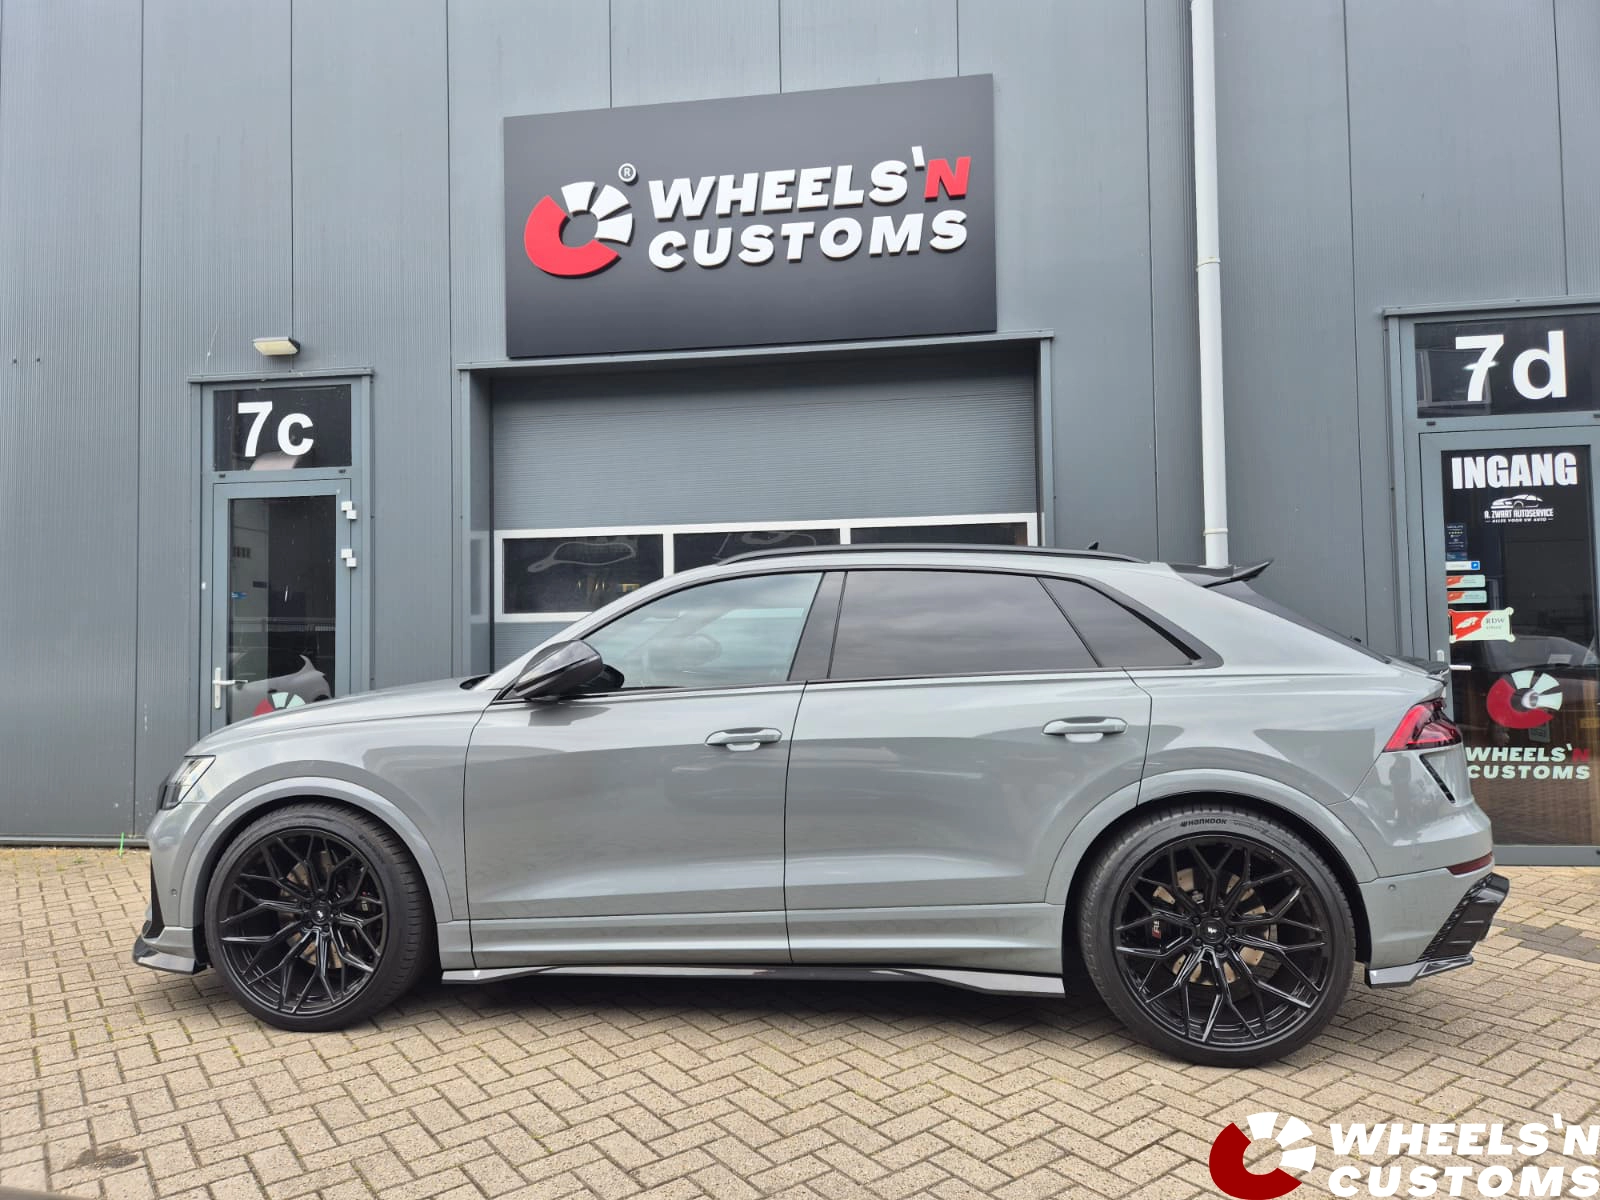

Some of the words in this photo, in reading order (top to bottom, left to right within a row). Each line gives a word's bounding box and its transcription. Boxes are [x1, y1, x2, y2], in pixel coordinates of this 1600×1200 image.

[648, 145, 972, 219] WHEELS'N
[648, 209, 968, 270] CUSTOMS
[1455, 330, 1568, 402] 7d
[237, 401, 315, 458] 7c
[1451, 452, 1579, 490] INGANG
[1513, 508, 1554, 518] AUTOSERVICE
[1467, 764, 1591, 779] CUSTOMS
